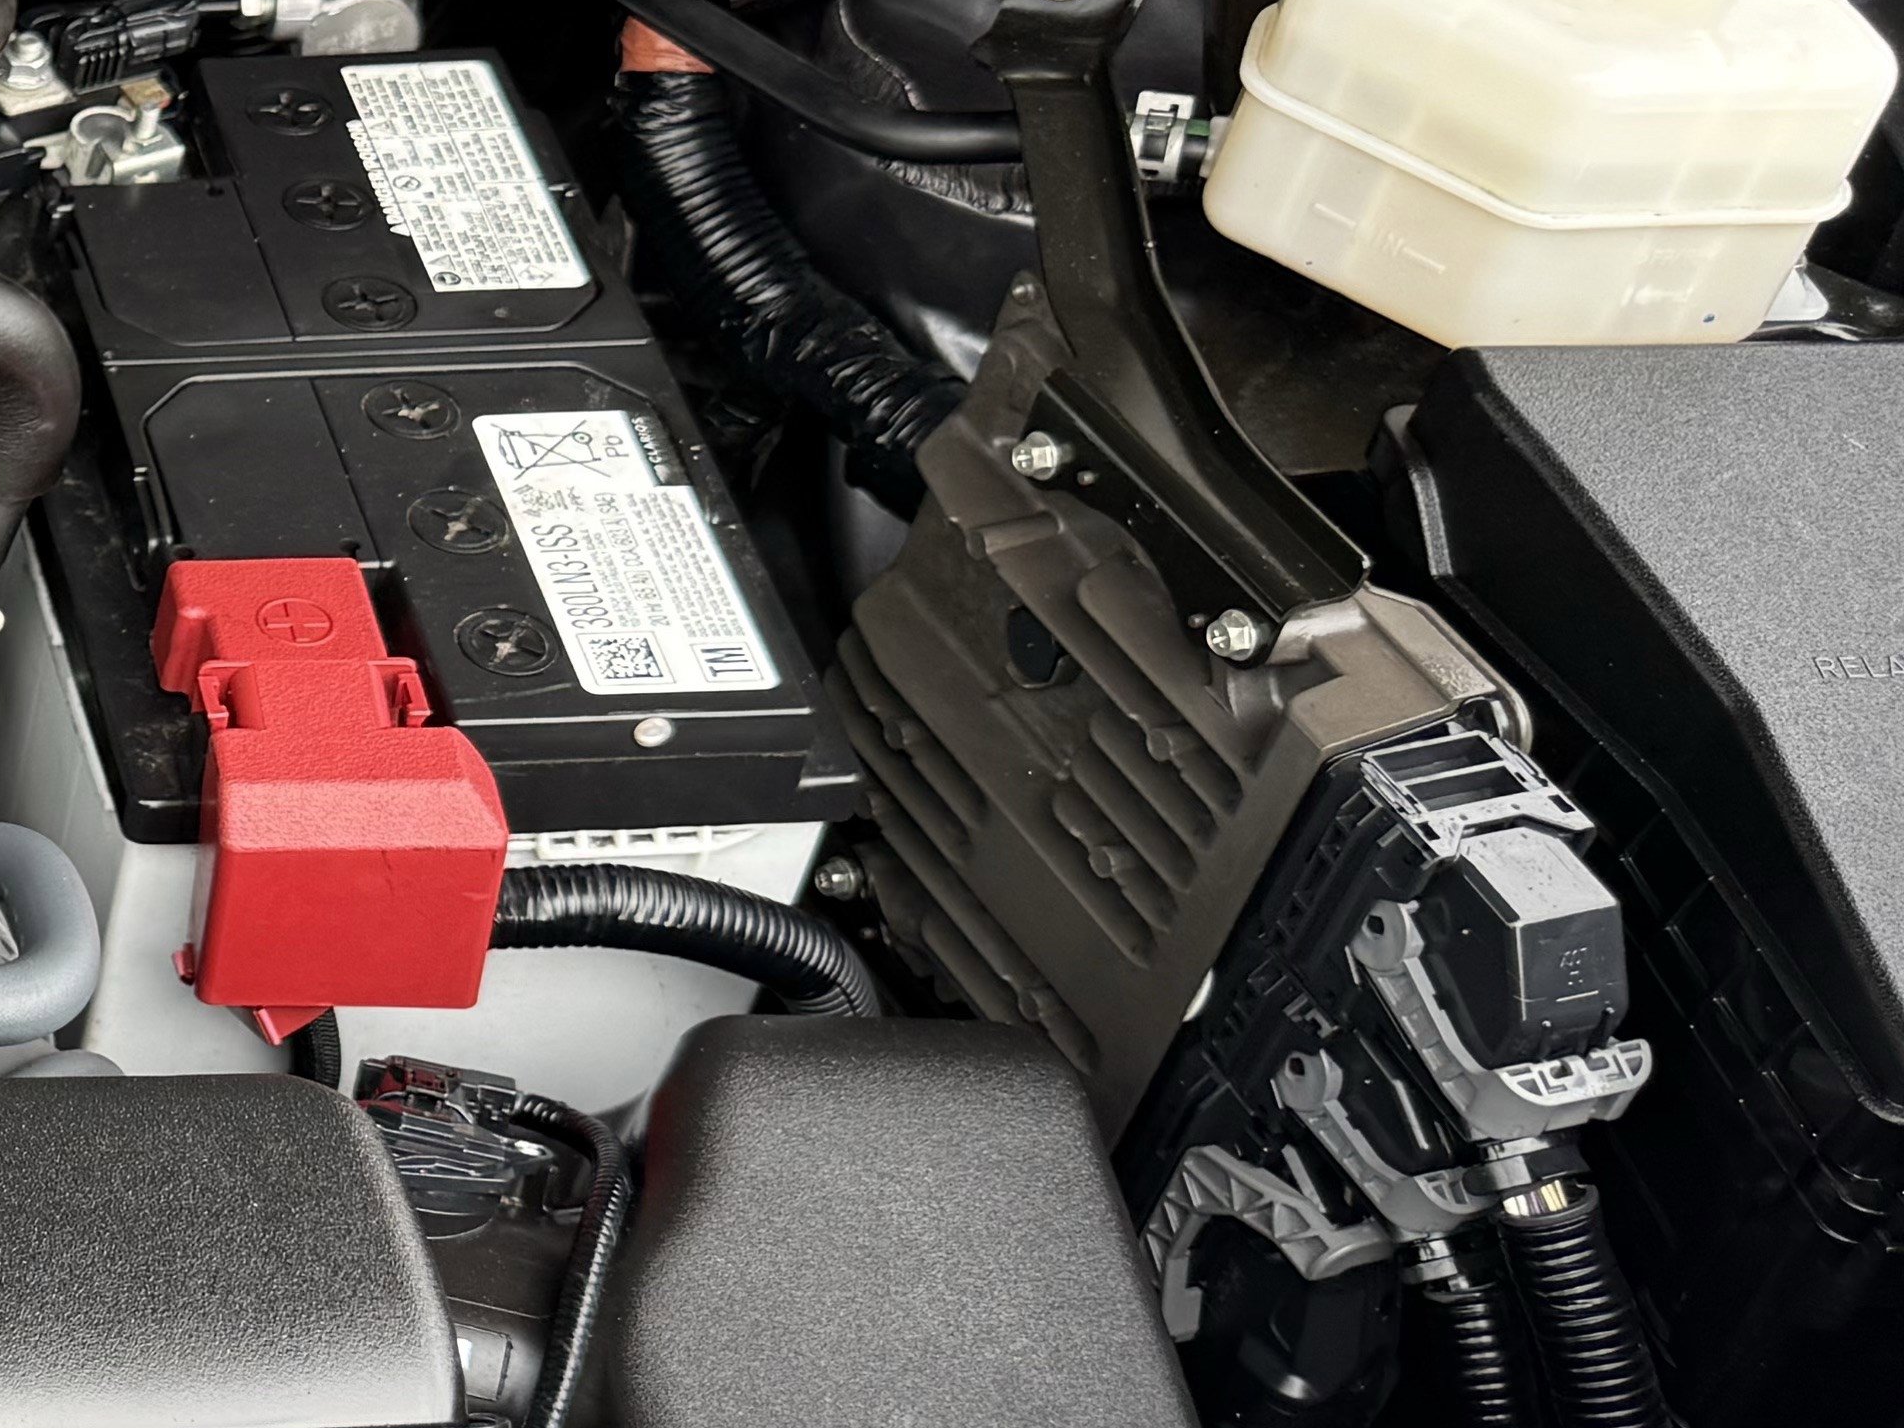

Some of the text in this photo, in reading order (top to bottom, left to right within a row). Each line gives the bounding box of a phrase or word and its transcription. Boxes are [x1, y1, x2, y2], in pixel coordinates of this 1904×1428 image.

[600, 435, 629, 458] Pb
[531, 525, 613, 629] 380LN3-ISS
[701, 647, 754, 678] TM
